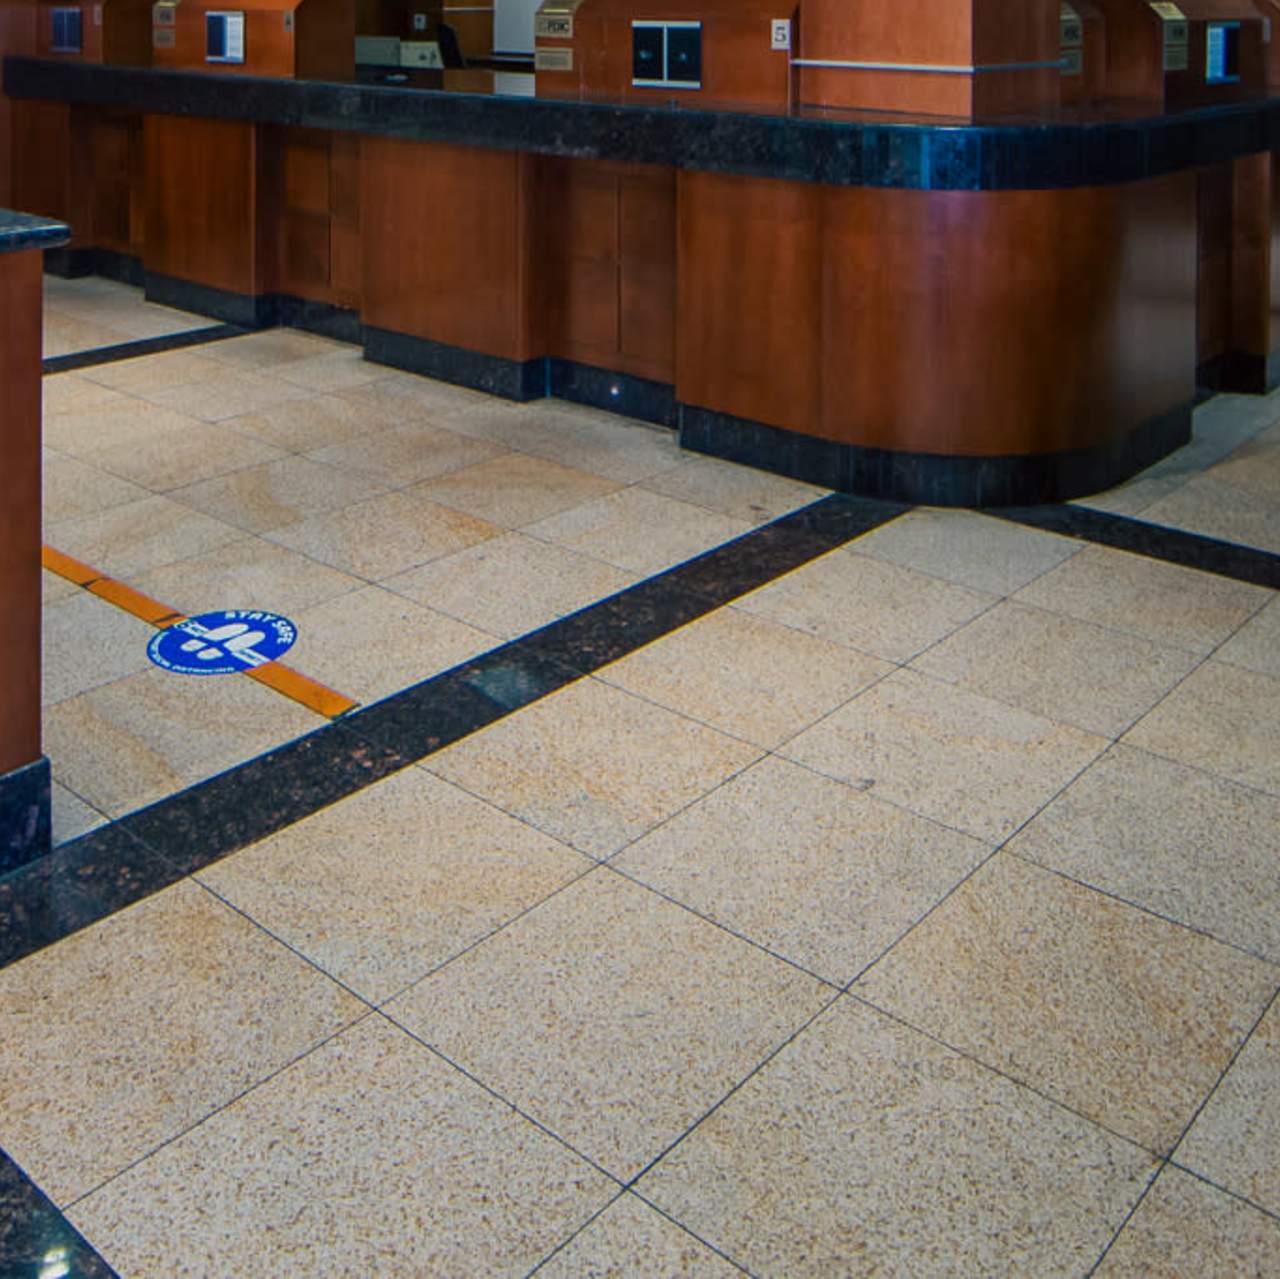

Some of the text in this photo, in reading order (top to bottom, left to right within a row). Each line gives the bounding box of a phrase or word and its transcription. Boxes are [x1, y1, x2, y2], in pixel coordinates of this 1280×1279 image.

[774, 26, 787, 43] 5
[224, 611, 294, 644] STAY SAFE
